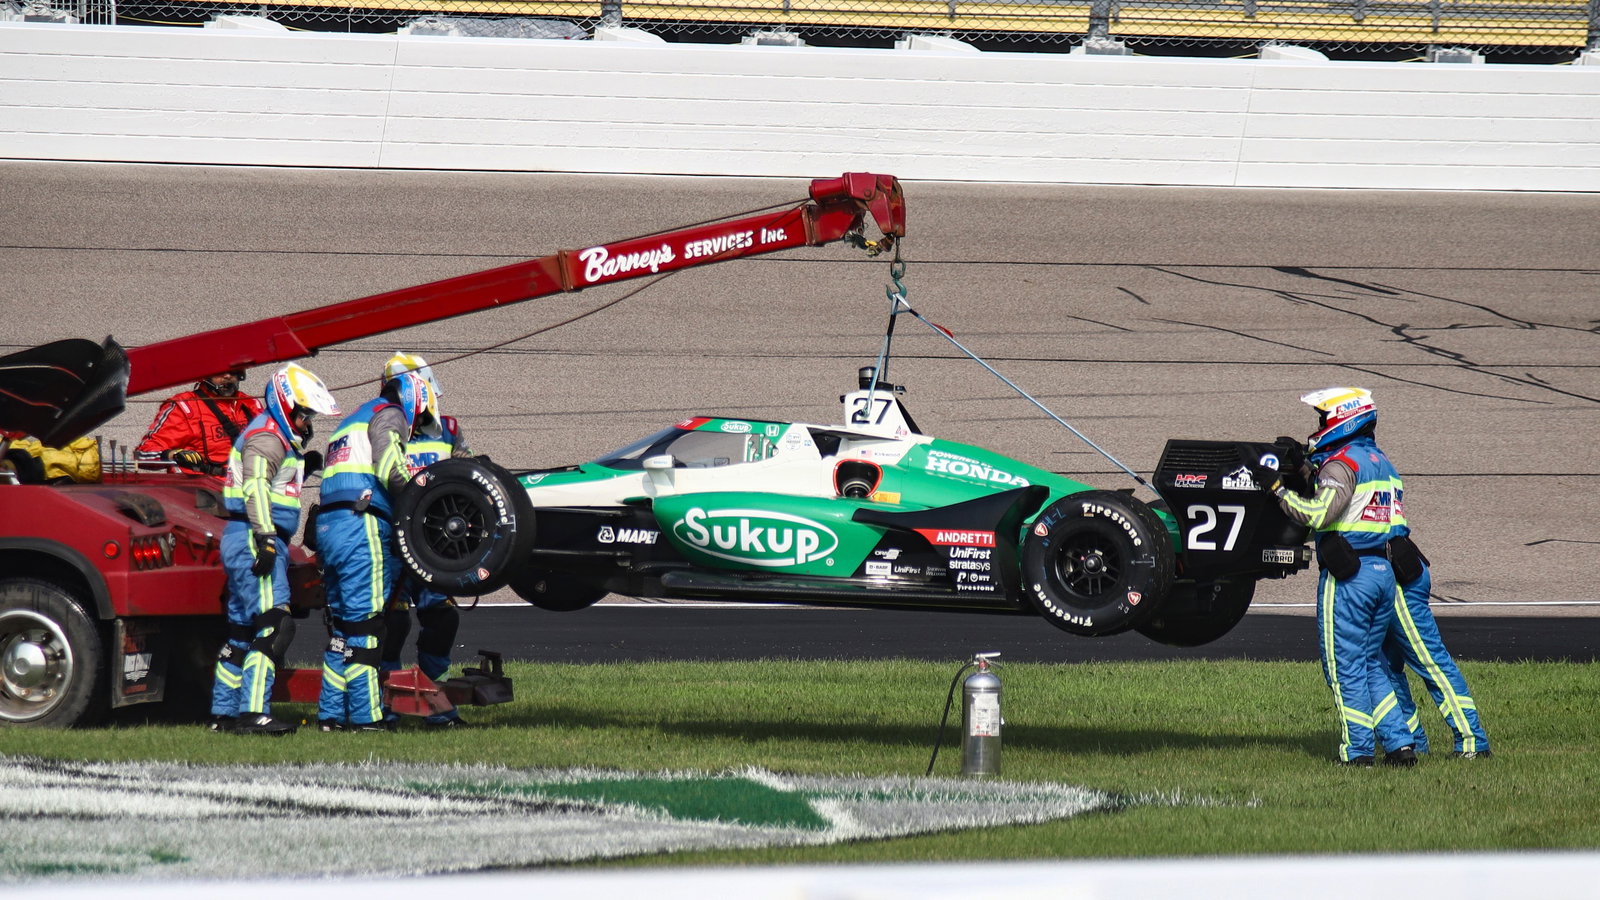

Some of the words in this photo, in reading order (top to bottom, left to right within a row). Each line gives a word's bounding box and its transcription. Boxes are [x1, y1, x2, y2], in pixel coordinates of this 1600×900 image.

[579, 244, 676, 282] Barney's
[684, 231, 754, 259] SERVICES
[851, 397, 893, 425] 27
[722, 421, 750, 433] Sukup
[928, 450, 980, 465] POWERED
[925, 456, 1030, 487] HONDA
[472, 470, 508, 524] Firestone
[685, 507, 820, 565] Sukup
[1082, 503, 1142, 547] Firestone
[1187, 505, 1246, 551] 27
[616, 529, 658, 545] MAPEI
[936, 532, 993, 545] ANDRETTI
[397, 529, 433, 582] Firestone
[949, 547, 992, 560] UniFirst
[1263, 555, 1293, 563] HYBRID
[893, 566, 921, 574] UniFirst
[949, 560, 991, 572] stratasys
[957, 584, 995, 592] Firestone
[1033, 583, 1093, 627] Firestone
